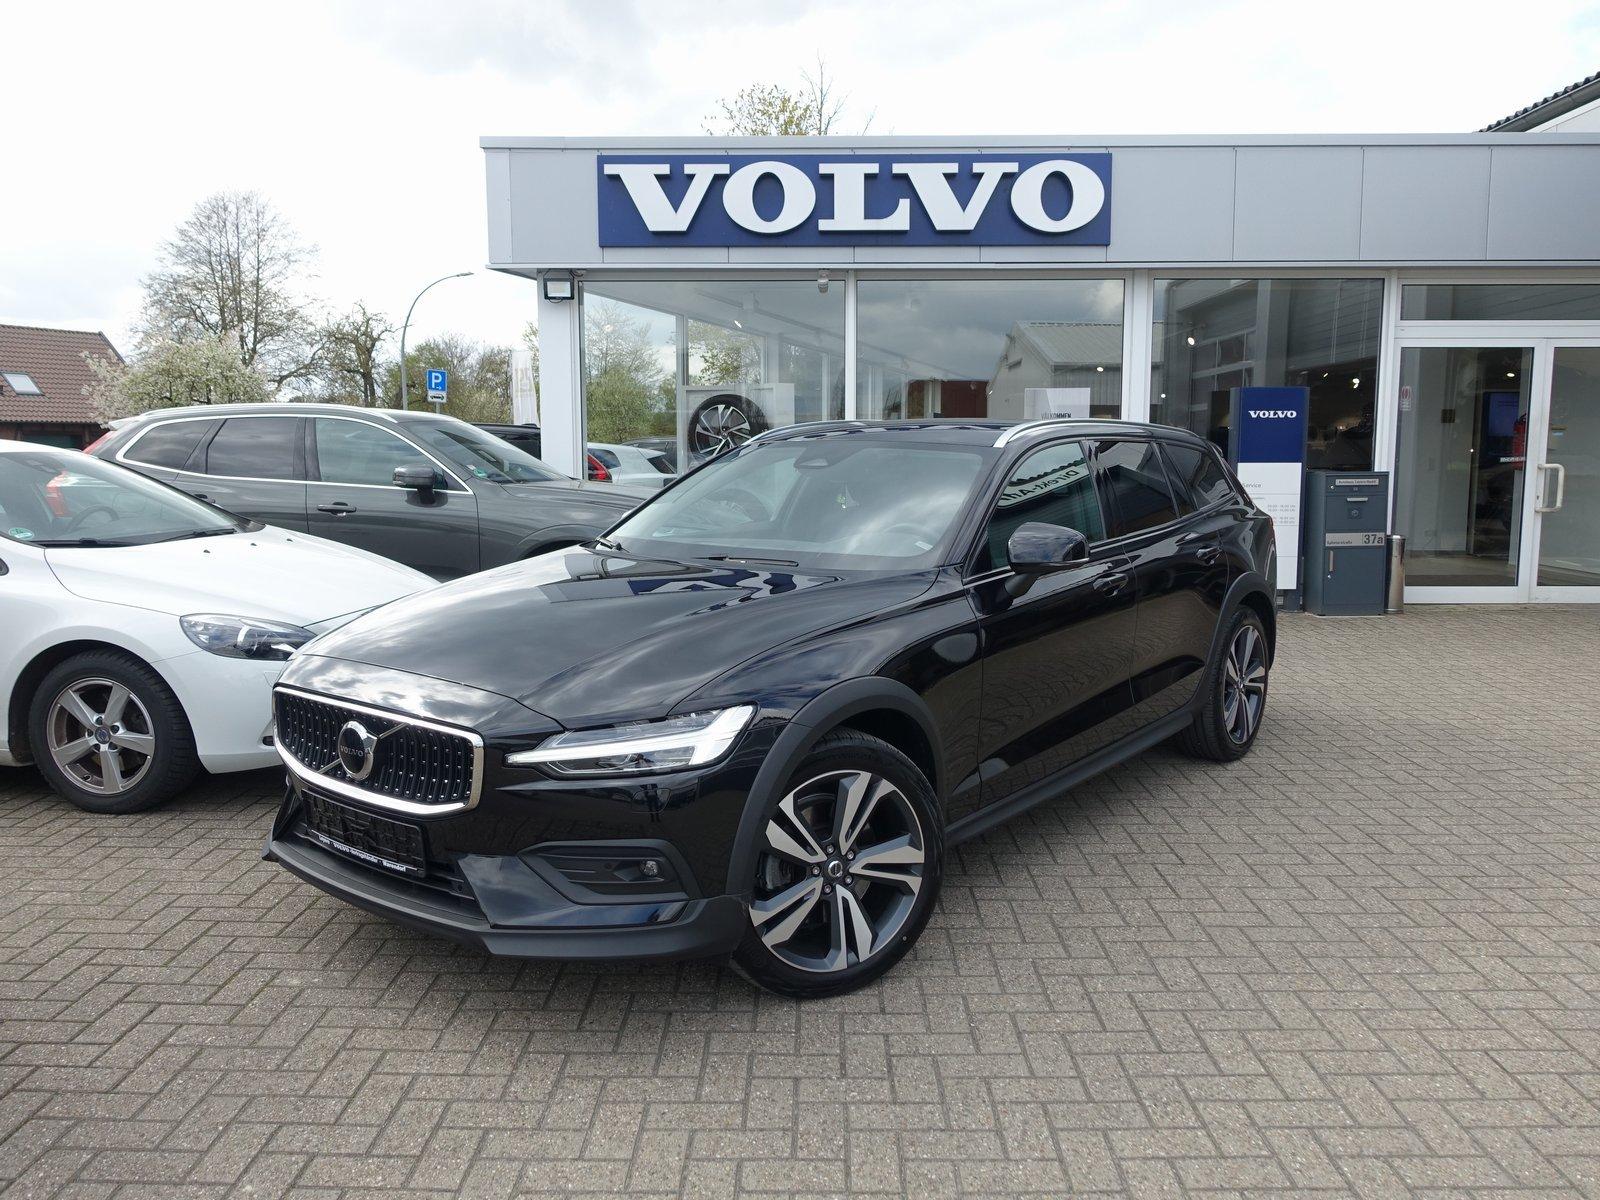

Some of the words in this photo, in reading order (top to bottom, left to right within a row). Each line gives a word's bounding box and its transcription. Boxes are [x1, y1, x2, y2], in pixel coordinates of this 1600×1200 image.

[603, 159, 1106, 234] VOLVO
[431, 372, 443, 389] P
[1248, 410, 1297, 419] VOLVO
[1363, 533, 1384, 545] 37a
[340, 744, 364, 757] VOLVO
